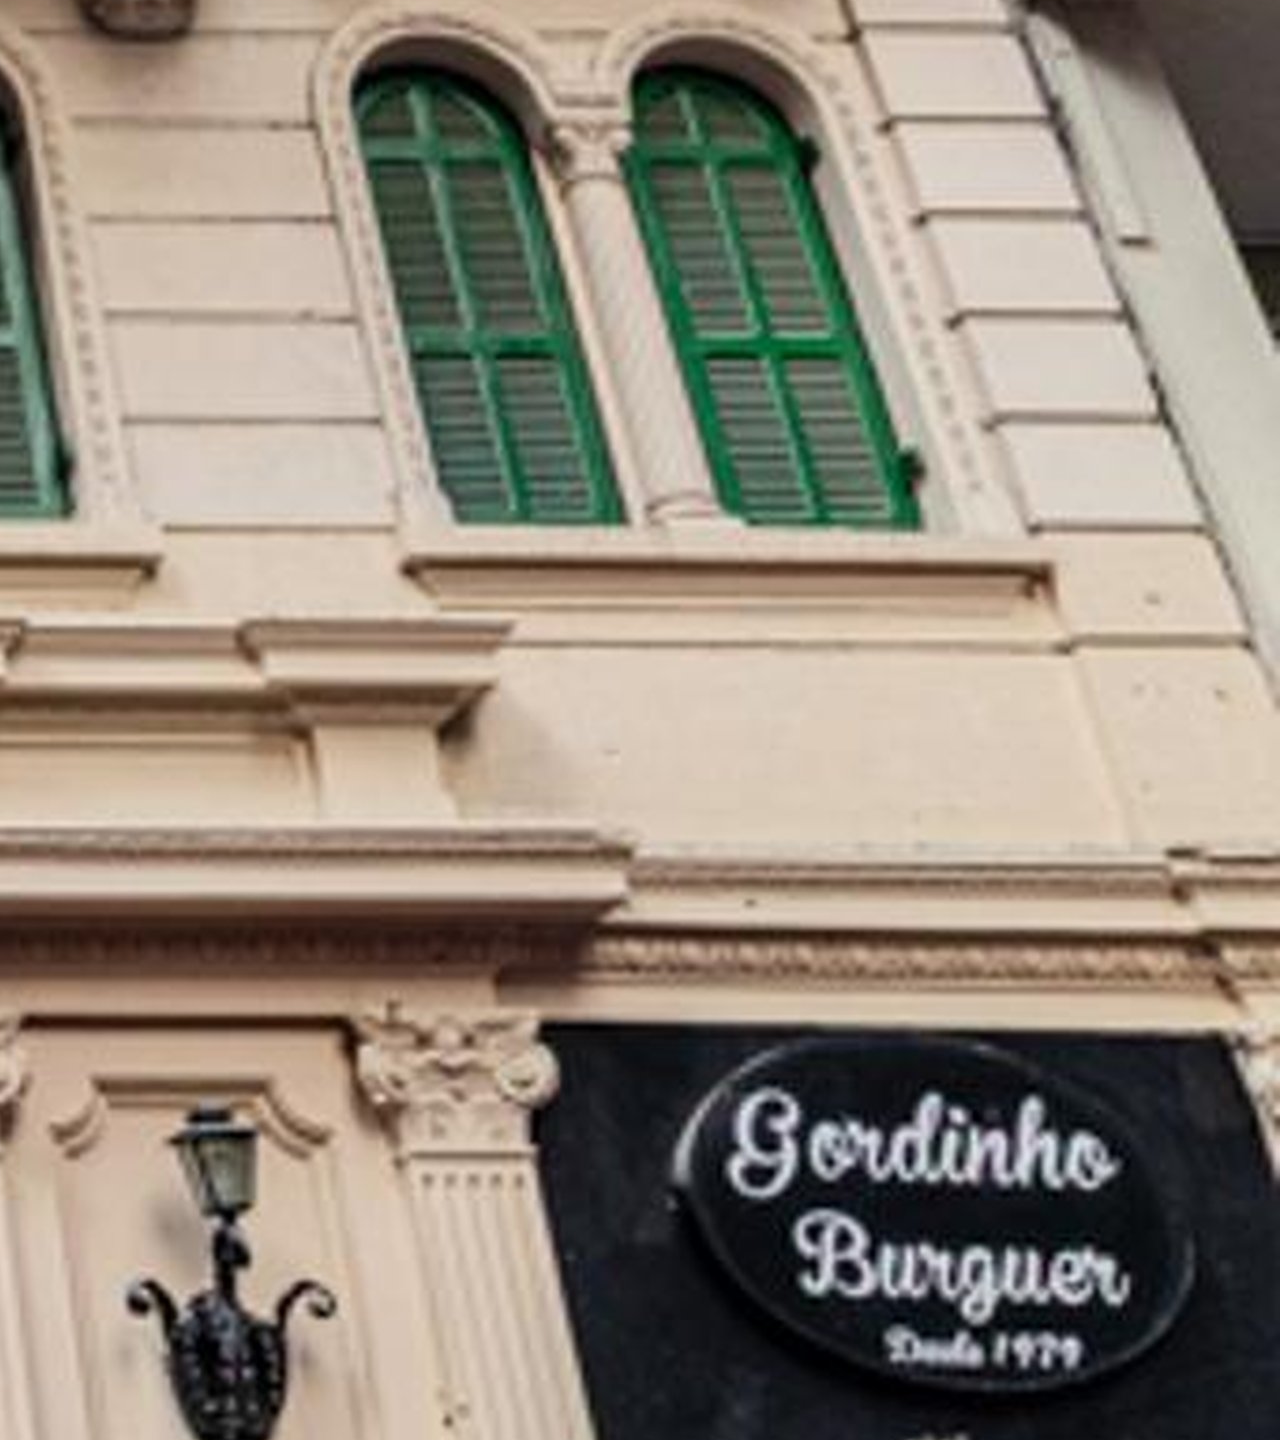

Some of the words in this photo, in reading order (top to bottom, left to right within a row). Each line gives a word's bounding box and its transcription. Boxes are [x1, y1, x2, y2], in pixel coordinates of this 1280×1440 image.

[727, 1086, 1121, 1198] Gordinho
[792, 1208, 1131, 1325] Burguer
[883, 1324, 985, 1367] Desde
